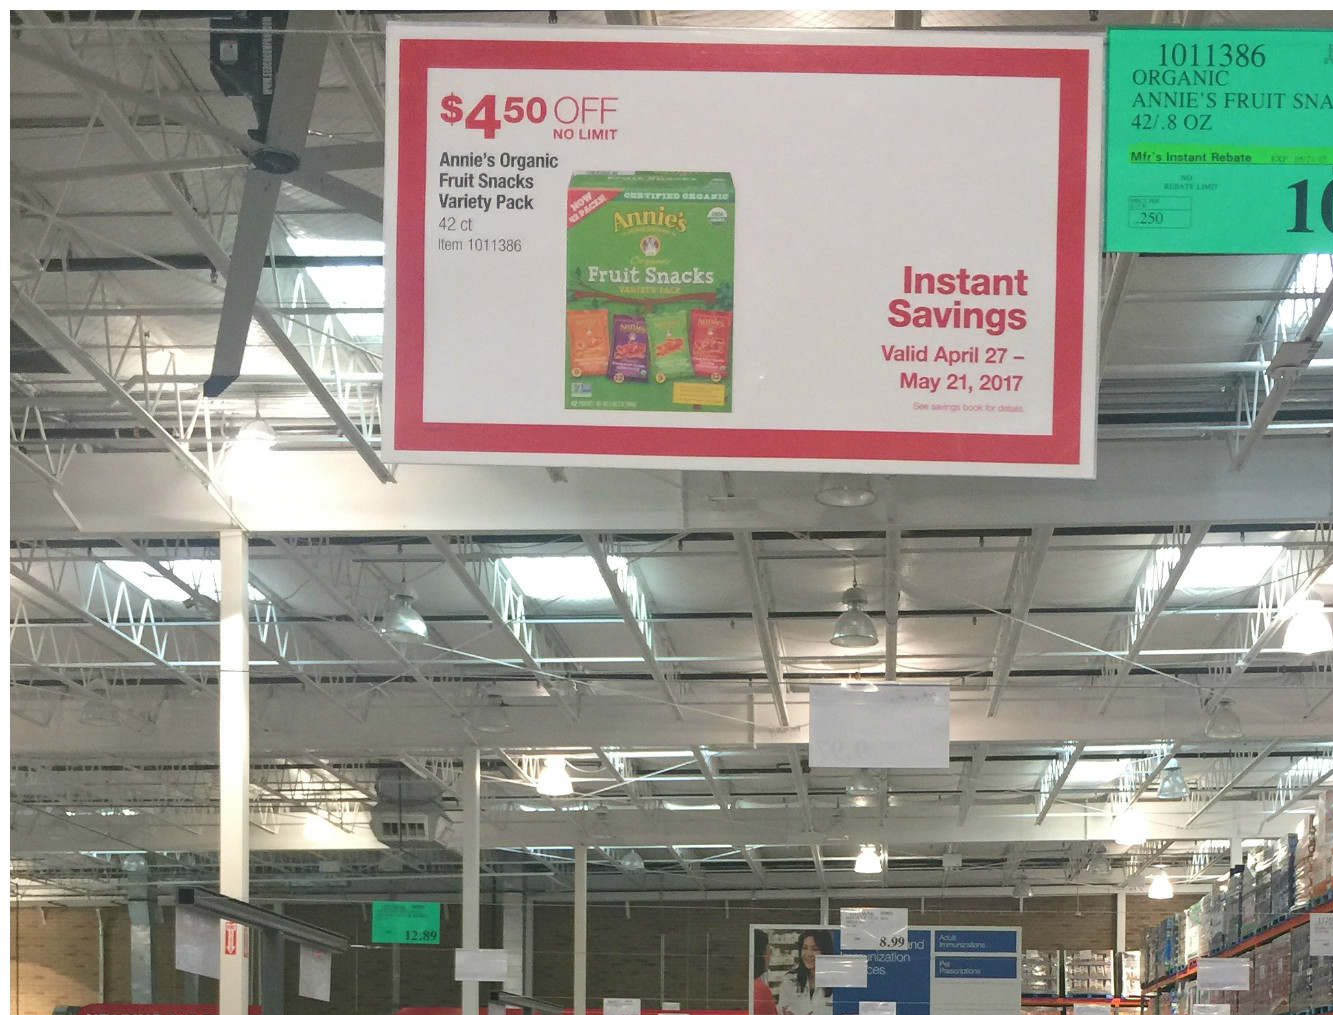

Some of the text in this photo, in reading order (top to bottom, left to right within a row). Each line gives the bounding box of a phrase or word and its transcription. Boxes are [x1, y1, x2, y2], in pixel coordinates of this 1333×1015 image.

[1159, 43, 1266, 68] 1011386
[1132, 69, 1229, 86] ORGANIC
[1132, 92, 1217, 108] ANNIE'S
[1224, 93, 1286, 109] FRUIT
[554, 96, 619, 124] OFF
[1131, 114, 1212, 130] 42/.8 OZ
[553, 129, 618, 140] NO LIMIT
[440, 152, 558, 170] Annie's Organic
[1131, 152, 1161, 162] Mfr's
[1166, 152, 1207, 162] Instant
[1211, 153, 1252, 162] Rebate
[439, 173, 533, 188] Fruit Snacks
[439, 194, 534, 211] Variety Pack
[439, 217, 472, 231] 42 ct
[1135, 211, 1164, 225] .250
[438, 238, 521, 252] Item 1011386
[904, 266, 1028, 296] Instant
[888, 299, 1027, 335] Savings
[881, 345, 1007, 366] Valid April 27
[901, 372, 1023, 393] May 21, 2017
[913, 402, 928, 410] See
[963, 403, 983, 411] book
[986, 403, 995, 411] for
[406, 930, 437, 941] 12.89
[879, 936, 905, 948] 8.99
